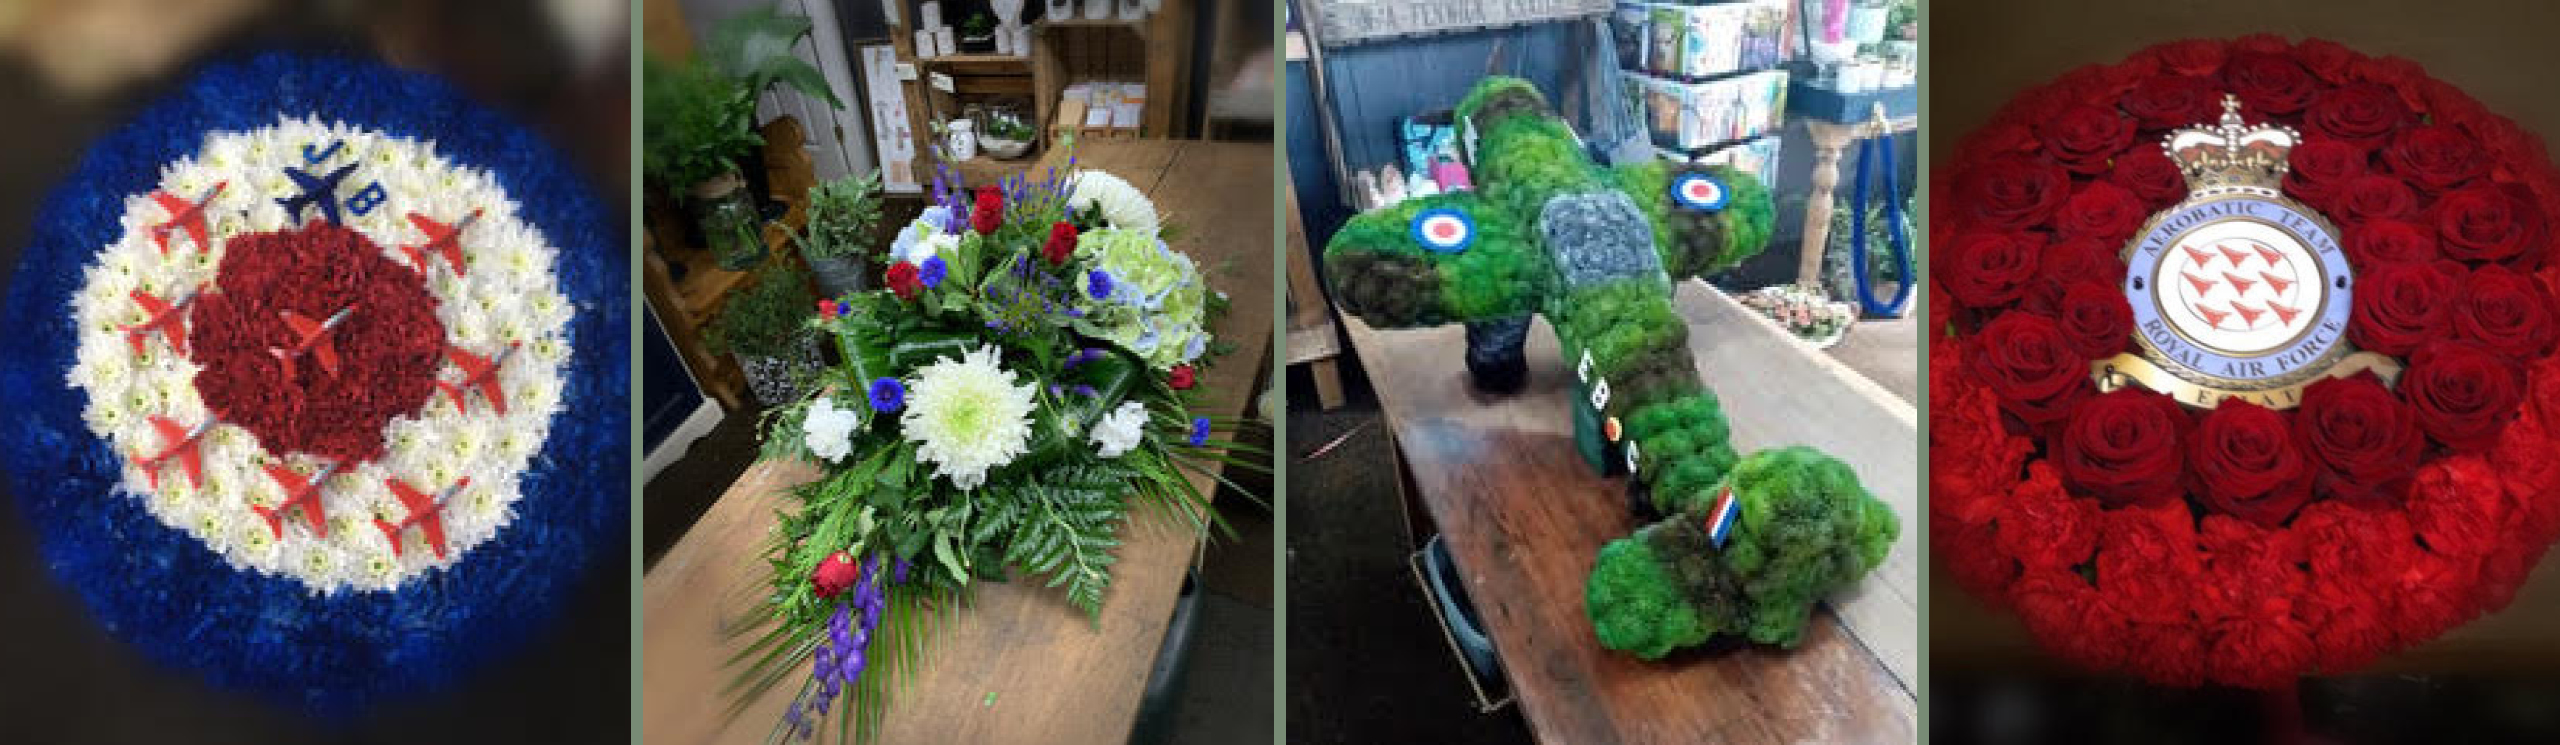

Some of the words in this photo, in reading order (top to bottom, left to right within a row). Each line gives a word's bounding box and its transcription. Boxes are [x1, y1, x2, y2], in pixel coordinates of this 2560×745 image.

[346, 180, 387, 216] B
[2143, 201, 2262, 258] AEROBATIC
[2278, 209, 2336, 255] TEAM
[2144, 318, 2204, 369] ROYAL
[2220, 360, 2266, 377] AIR
[2275, 317, 2341, 372] FORCE
[2197, 389, 2296, 406] EAT
